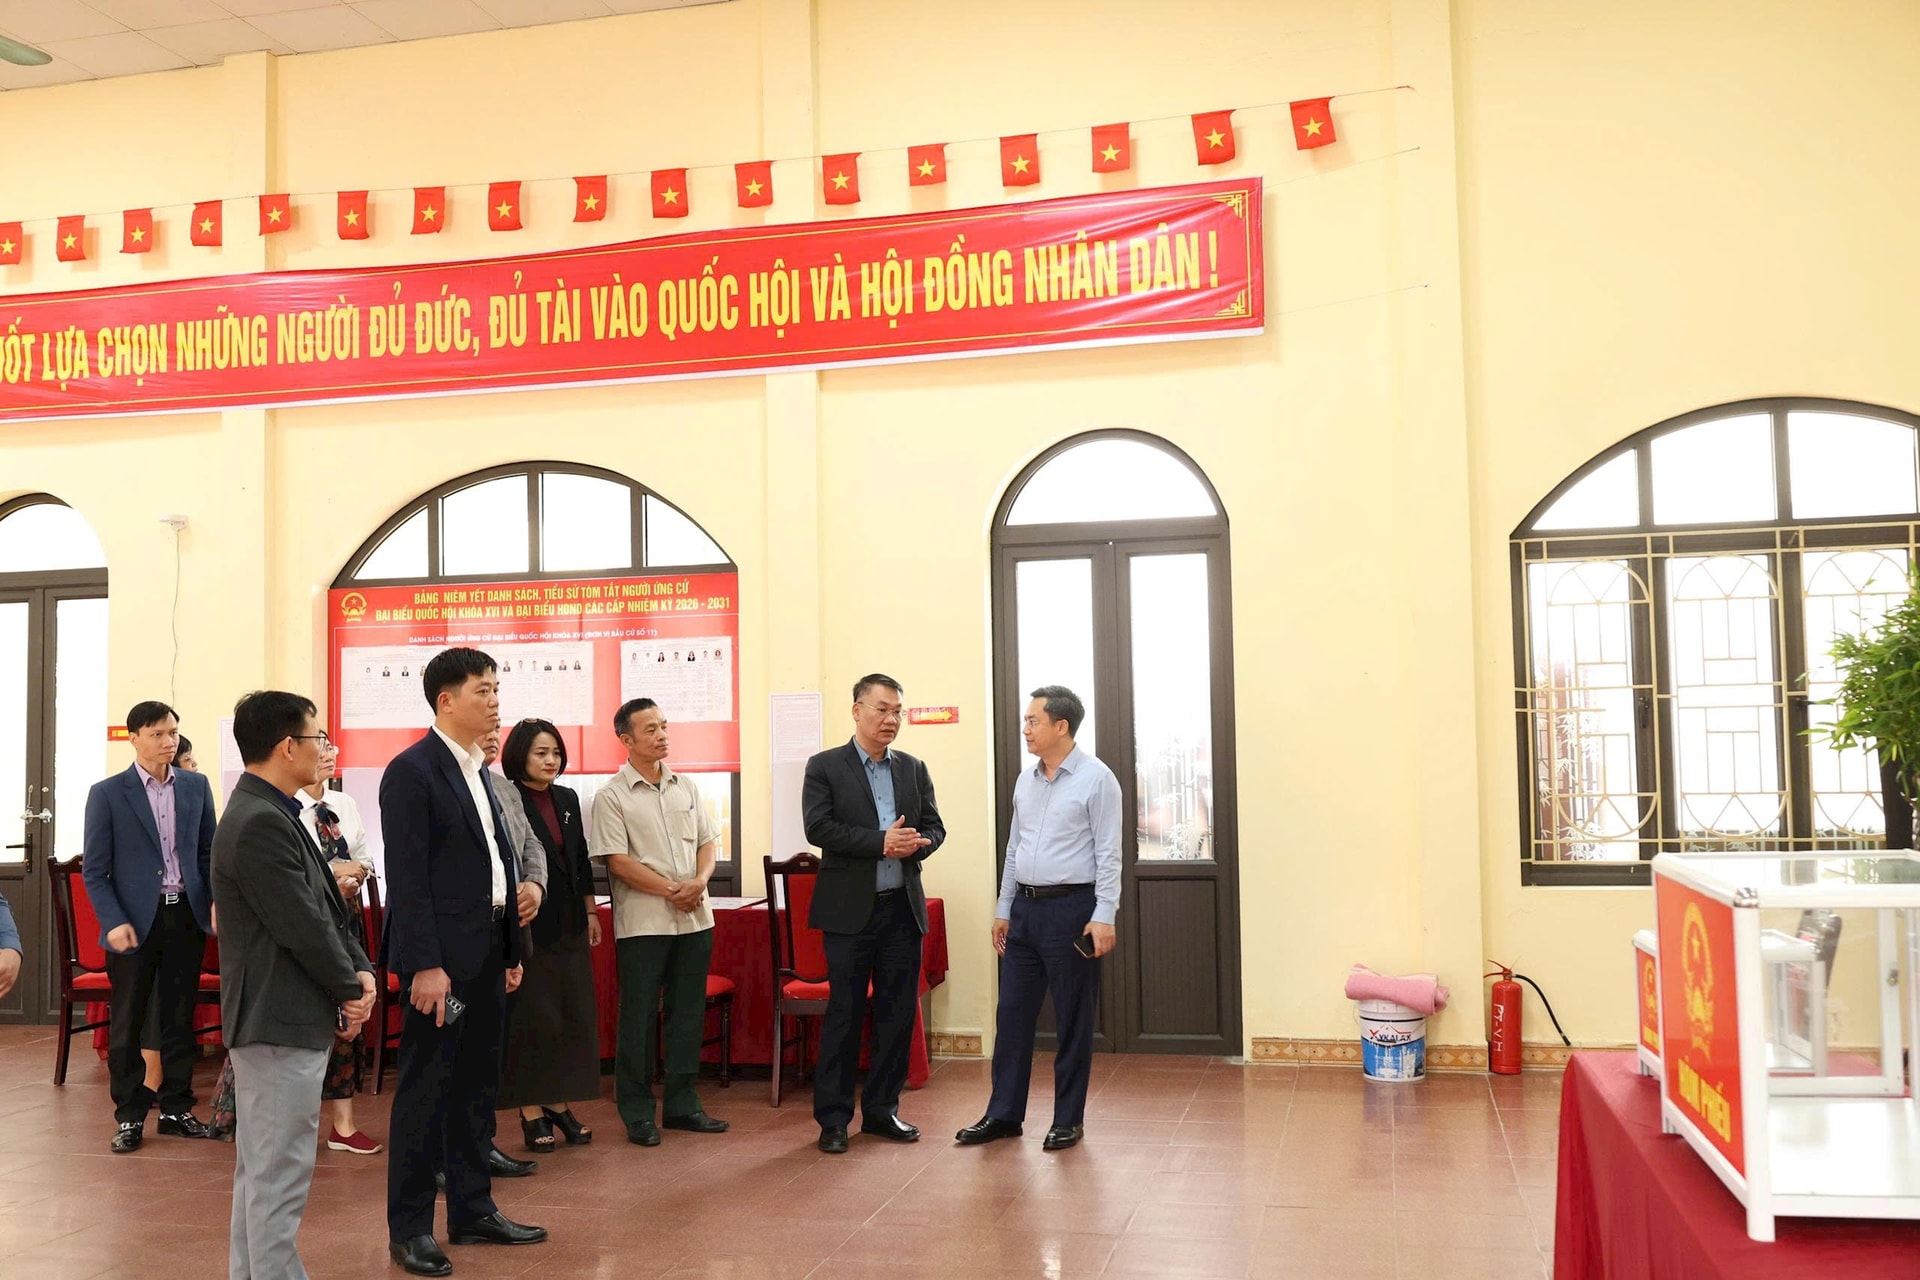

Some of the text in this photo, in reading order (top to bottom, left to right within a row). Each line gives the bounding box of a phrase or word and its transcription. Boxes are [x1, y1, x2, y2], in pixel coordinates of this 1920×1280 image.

[42, 325, 90, 391] LỰA
[97, 323, 168, 387] CHỌN
[176, 305, 267, 372] NHỮNG
[277, 295, 360, 365] NGƯỜI
[369, 281, 406, 357] ĐỦ
[415, 284, 479, 357] ĐỨC,
[489, 270, 527, 348] ĐỦ
[536, 278, 580, 344] TÀI
[590, 273, 648, 340] VÀO
[658, 256, 739, 341] QUỐC
[749, 258, 800, 338] HỘI
[810, 253, 851, 322] VÀ
[860, 248, 913, 328] HỘI
[923, 234, 1013, 312] ĐỒNG
[1024, 230, 1117, 304] NHÂN
[1129, 222, 1199, 295] DÂN
[1208, 230, 1219, 288] !
[414, 589, 439, 605] BẢNG
[443, 588, 467, 603] NIÊM
[469, 587, 485, 603] YẾT
[487, 590, 512, 602] DANH
[544, 583, 563, 600] TIỂU
[566, 585, 579, 599] SỬ
[581, 584, 601, 598] TÓM
[603, 581, 619, 597] TẮT
[622, 581, 650, 597] NGƯỜI
[653, 581, 673, 596] ỨNG
[676, 578, 690, 594] CỬ
[375, 609, 391, 624] ĐẠI
[393, 605, 413, 620] BIỂU
[415, 604, 439, 620] QUỐC
[441, 606, 457, 620] HỘI
[458, 605, 483, 619] KHÓA
[485, 605, 500, 618] XVI
[502, 603, 514, 618] VÀ
[516, 603, 532, 618] ĐẠI
[534, 599, 555, 616] BIỂU
[557, 602, 583, 616] HĐND
[585, 600, 604, 615] CÁC
[606, 598, 625, 614] CẤP
[627, 598, 658, 615] NHIỆM
[660, 596, 673, 612] KỲ
[675, 597, 699, 611] 2026
[707, 596, 731, 610] 2031
